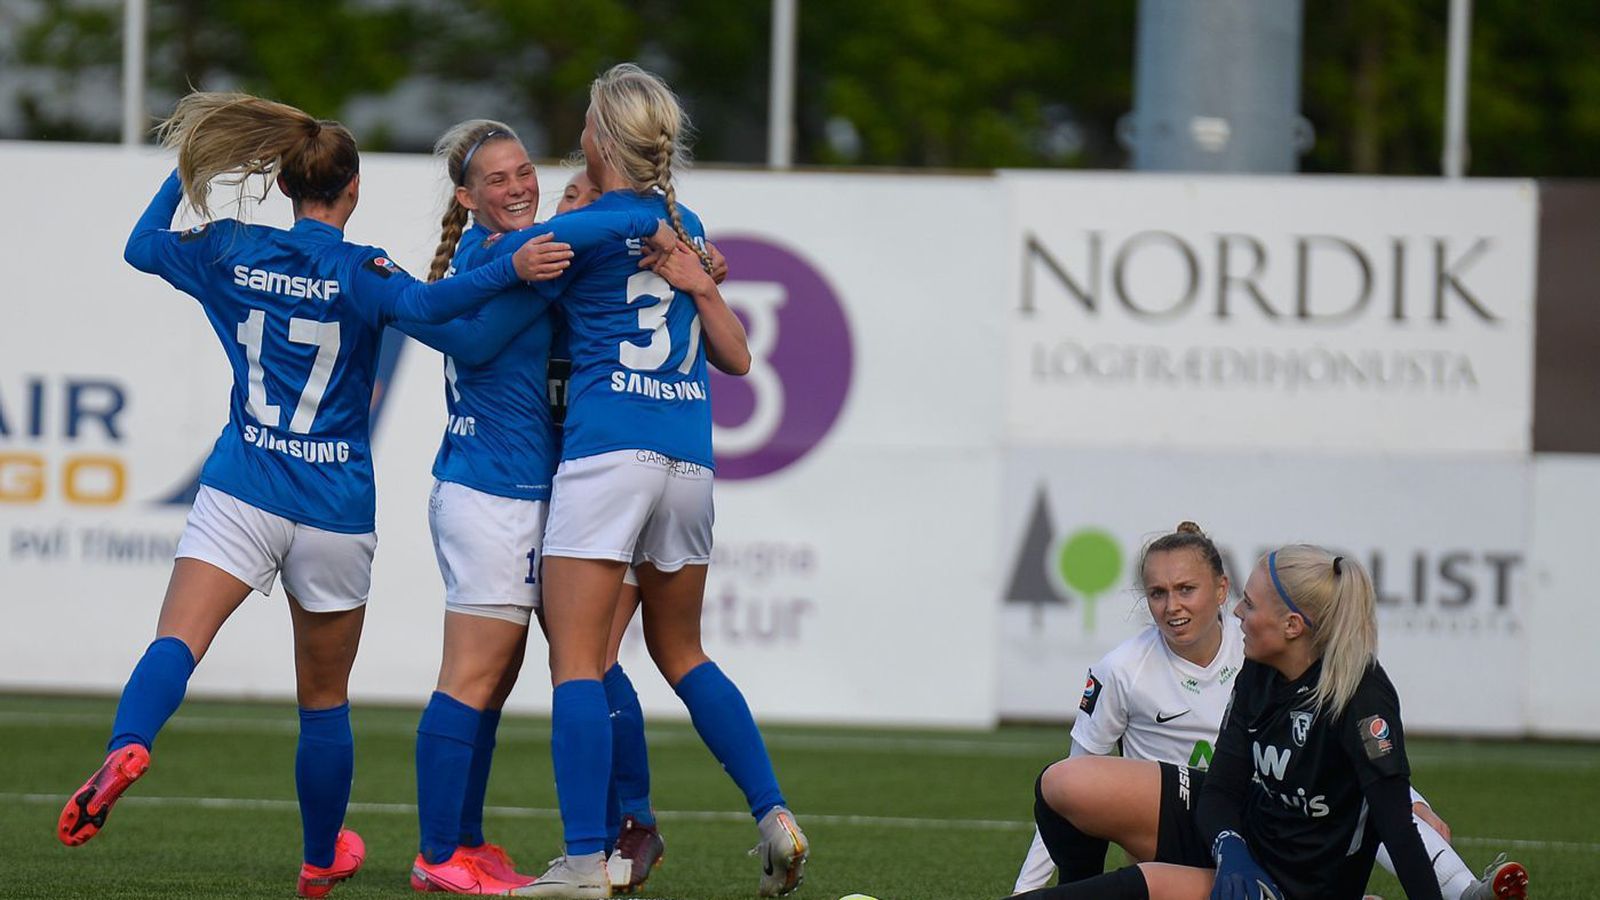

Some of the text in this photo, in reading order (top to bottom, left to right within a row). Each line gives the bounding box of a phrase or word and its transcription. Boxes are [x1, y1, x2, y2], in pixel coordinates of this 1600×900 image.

[233, 264, 340, 300] SAMSKP
[1018, 229, 1501, 325] NORDIK
[237, 308, 341, 434] 17
[611, 370, 706, 400] SAMSUN
[243, 424, 350, 463] SAMSUNG
[1178, 764, 1190, 810] OSE
